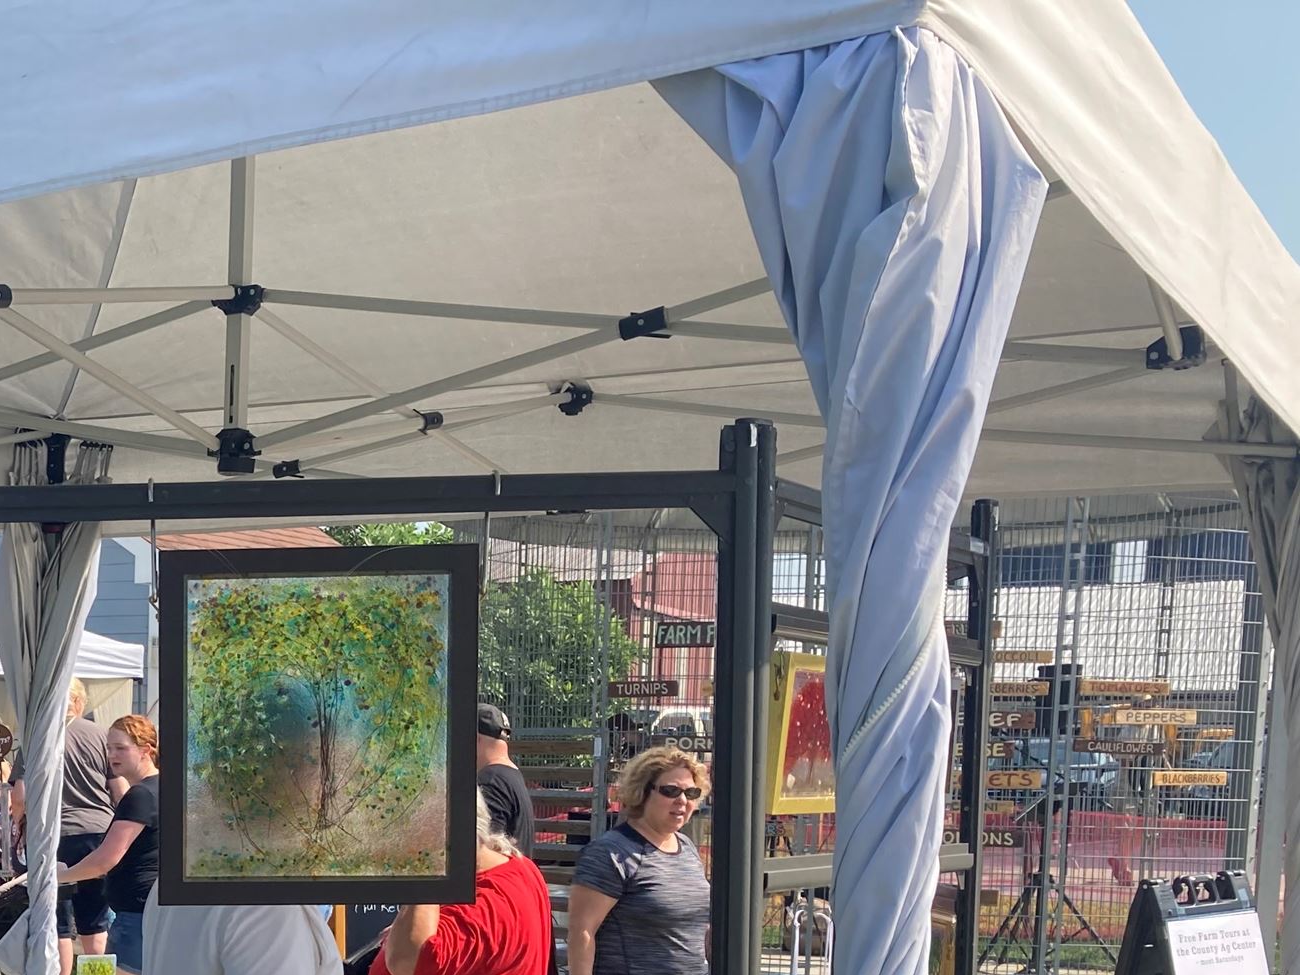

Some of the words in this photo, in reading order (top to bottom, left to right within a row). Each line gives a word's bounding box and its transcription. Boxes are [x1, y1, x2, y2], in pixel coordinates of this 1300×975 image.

[657, 625, 701, 644] FARM
[993, 651, 1039, 662] OCCOLI
[616, 682, 669, 695] TURNIPS
[1090, 681, 1162, 693] TOMATOES
[1126, 711, 1187, 723] PEPPERS
[1087, 741, 1154, 753] CAULIFLOWER
[1162, 773, 1221, 784] BLACKBERRIES
[1178, 934, 1197, 943] Free
[1198, 932, 1218, 941] Farm
[1219, 930, 1241, 939] Tours
[1242, 929, 1251, 937] at
[1176, 948, 1190, 957] the
[1191, 945, 1219, 955] County
[1220, 943, 1231, 953] Ag
[1232, 941, 1256, 951] Center
